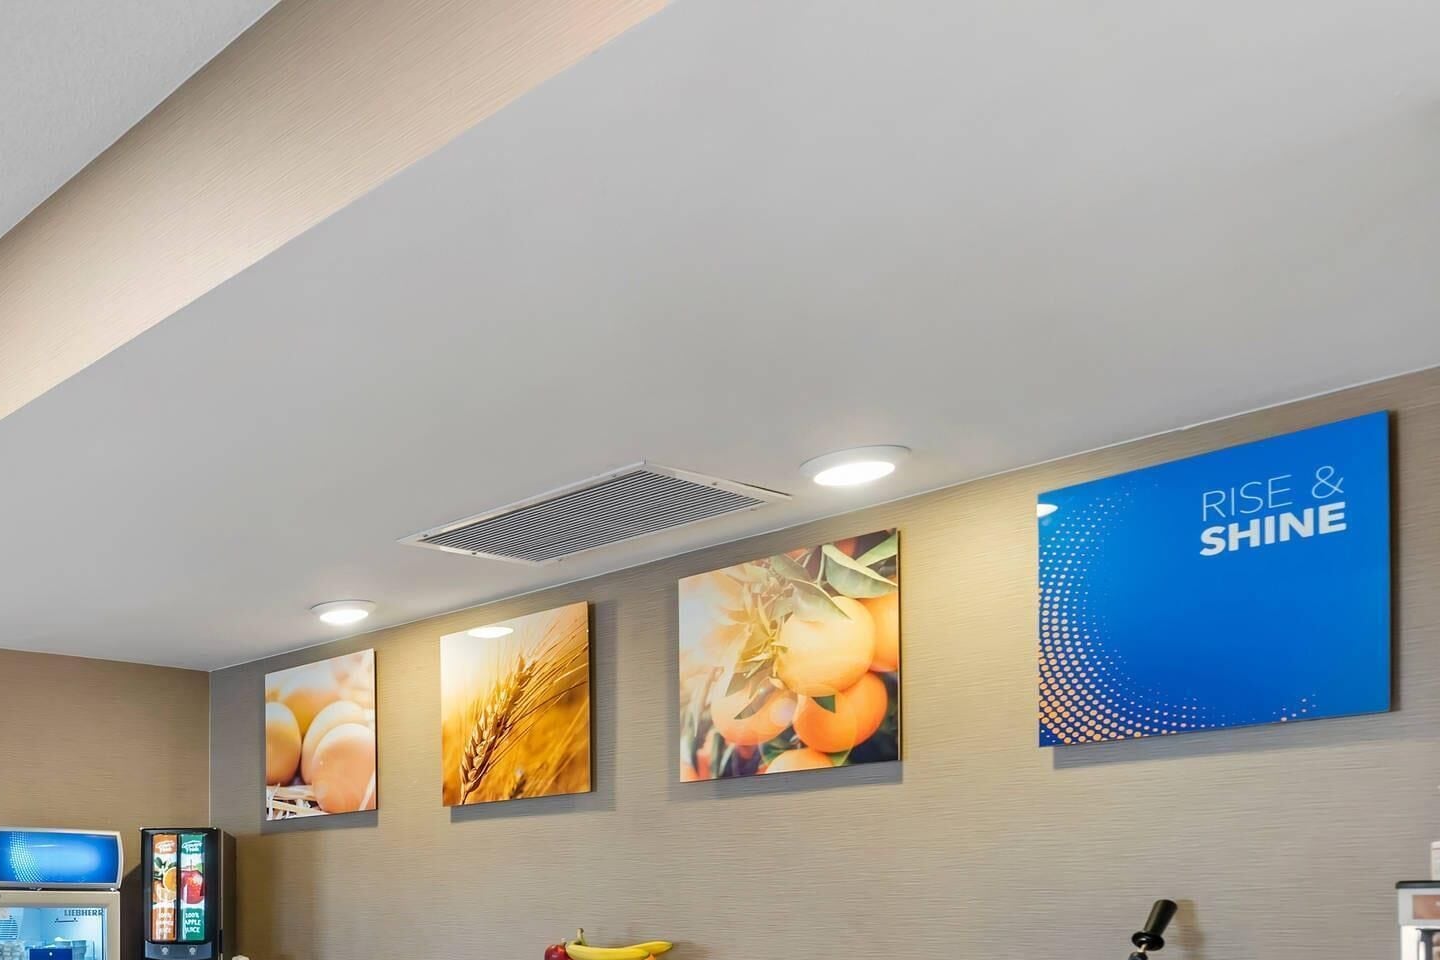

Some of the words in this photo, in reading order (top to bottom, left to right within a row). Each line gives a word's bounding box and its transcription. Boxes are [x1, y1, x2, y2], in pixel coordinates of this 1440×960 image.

[1202, 474, 1293, 522] RISE
[1311, 465, 1345, 499] &
[1199, 501, 1347, 557] SHINE
